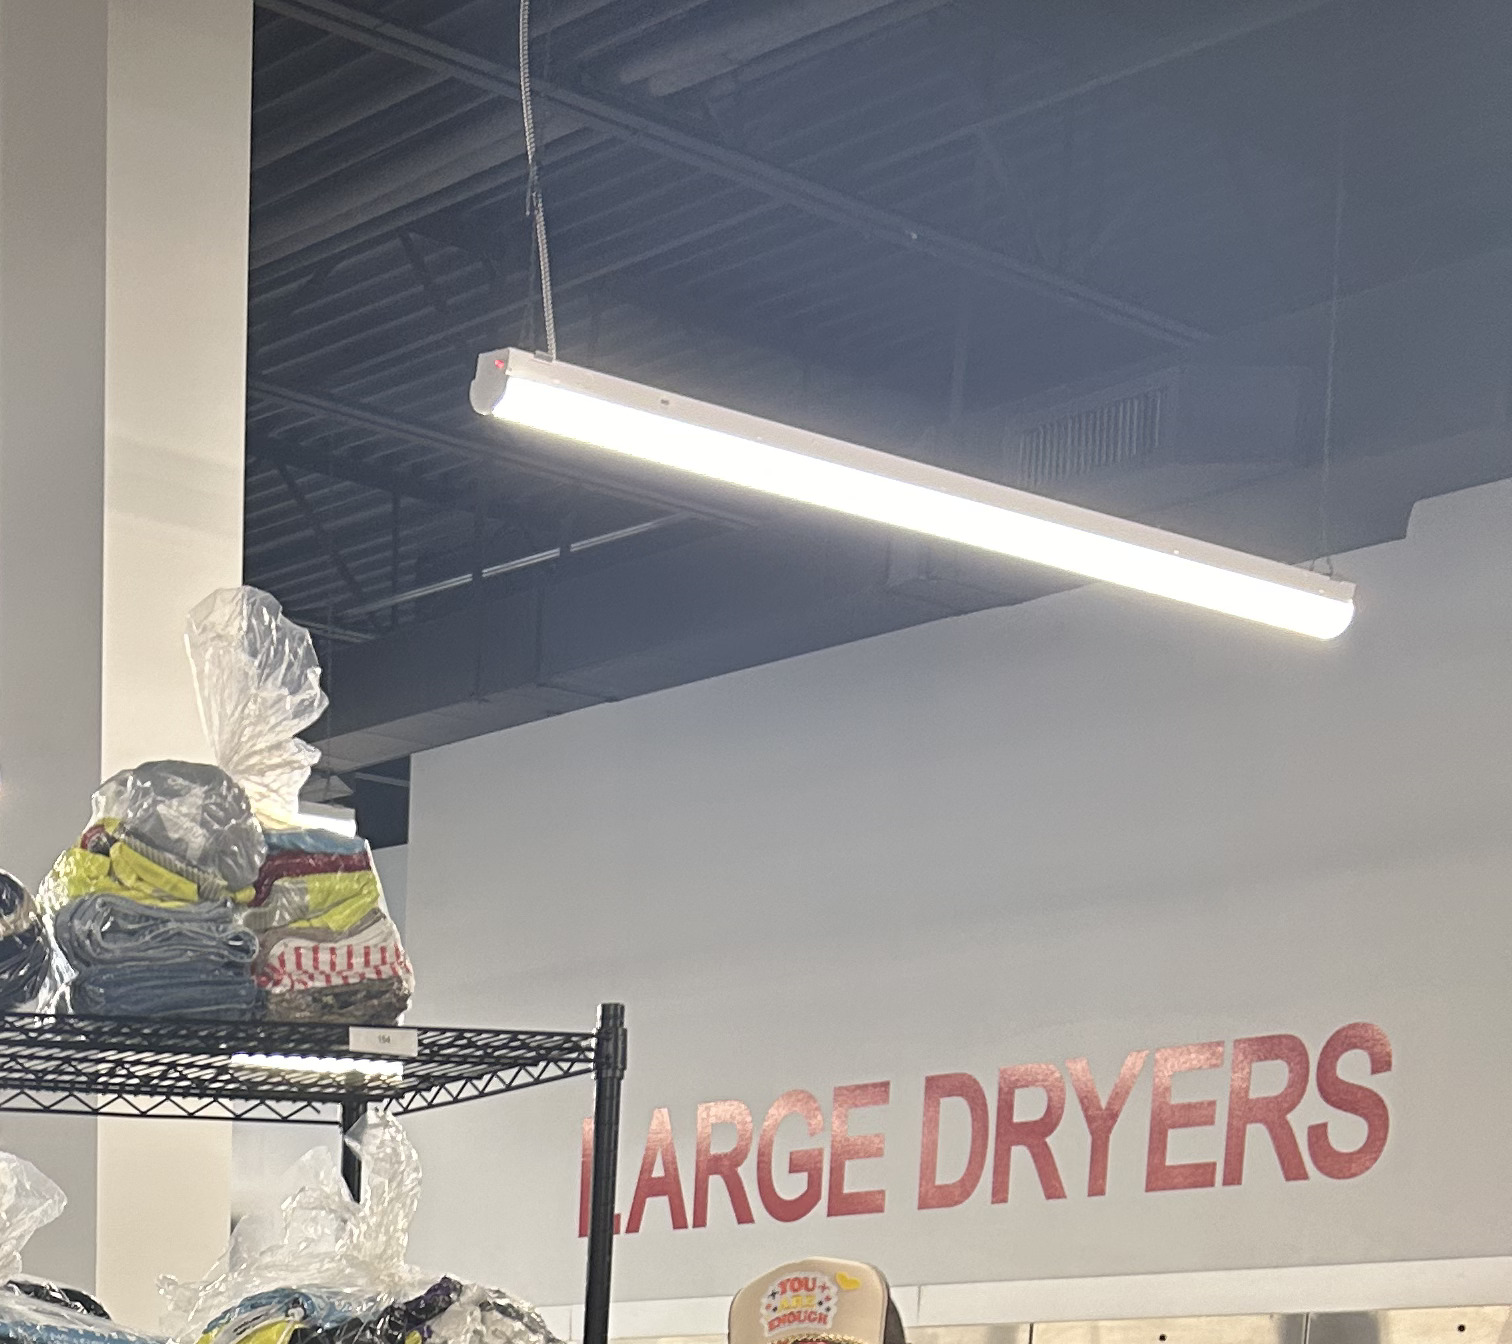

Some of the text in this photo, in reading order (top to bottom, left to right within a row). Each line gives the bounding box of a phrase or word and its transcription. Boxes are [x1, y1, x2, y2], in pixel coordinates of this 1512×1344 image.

[578, 1022, 1393, 1238] LARGE DRYERS
[777, 1276, 817, 1296] YOU
[777, 1294, 817, 1313] ARE
[767, 1309, 829, 1333] ENOUGH
